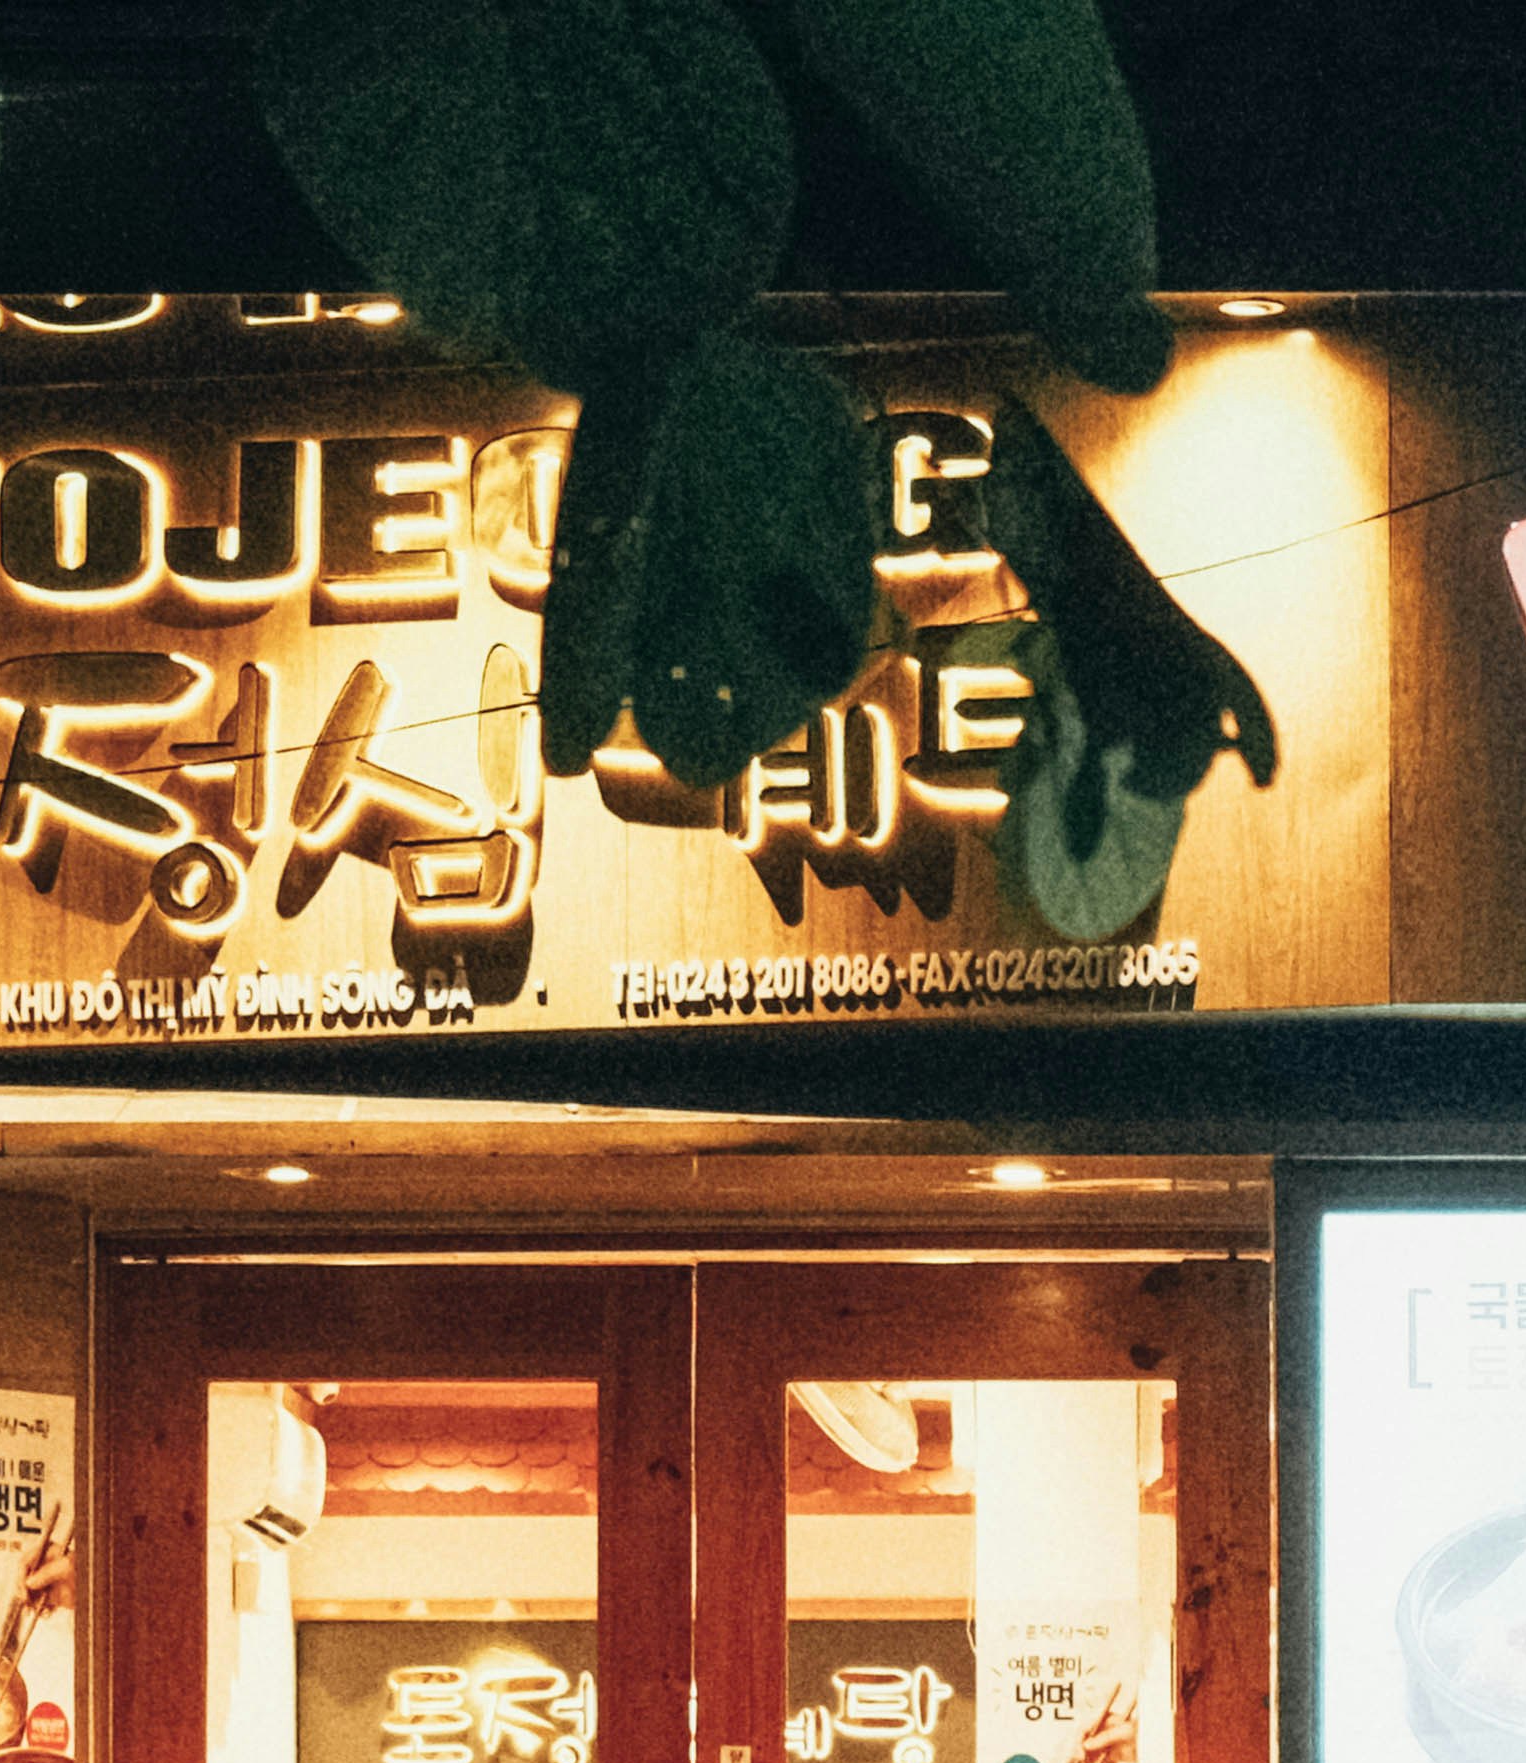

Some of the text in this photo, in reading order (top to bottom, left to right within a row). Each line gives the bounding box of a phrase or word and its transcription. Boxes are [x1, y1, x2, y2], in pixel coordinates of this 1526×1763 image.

[0, 980, 65, 1024] KHU
[321, 960, 415, 1015] SÔNG
[812, 953, 891, 997] 8086
[1008, 1655, 1082, 1679] 여름 별미
[1015, 1681, 1075, 1721] 냉면
